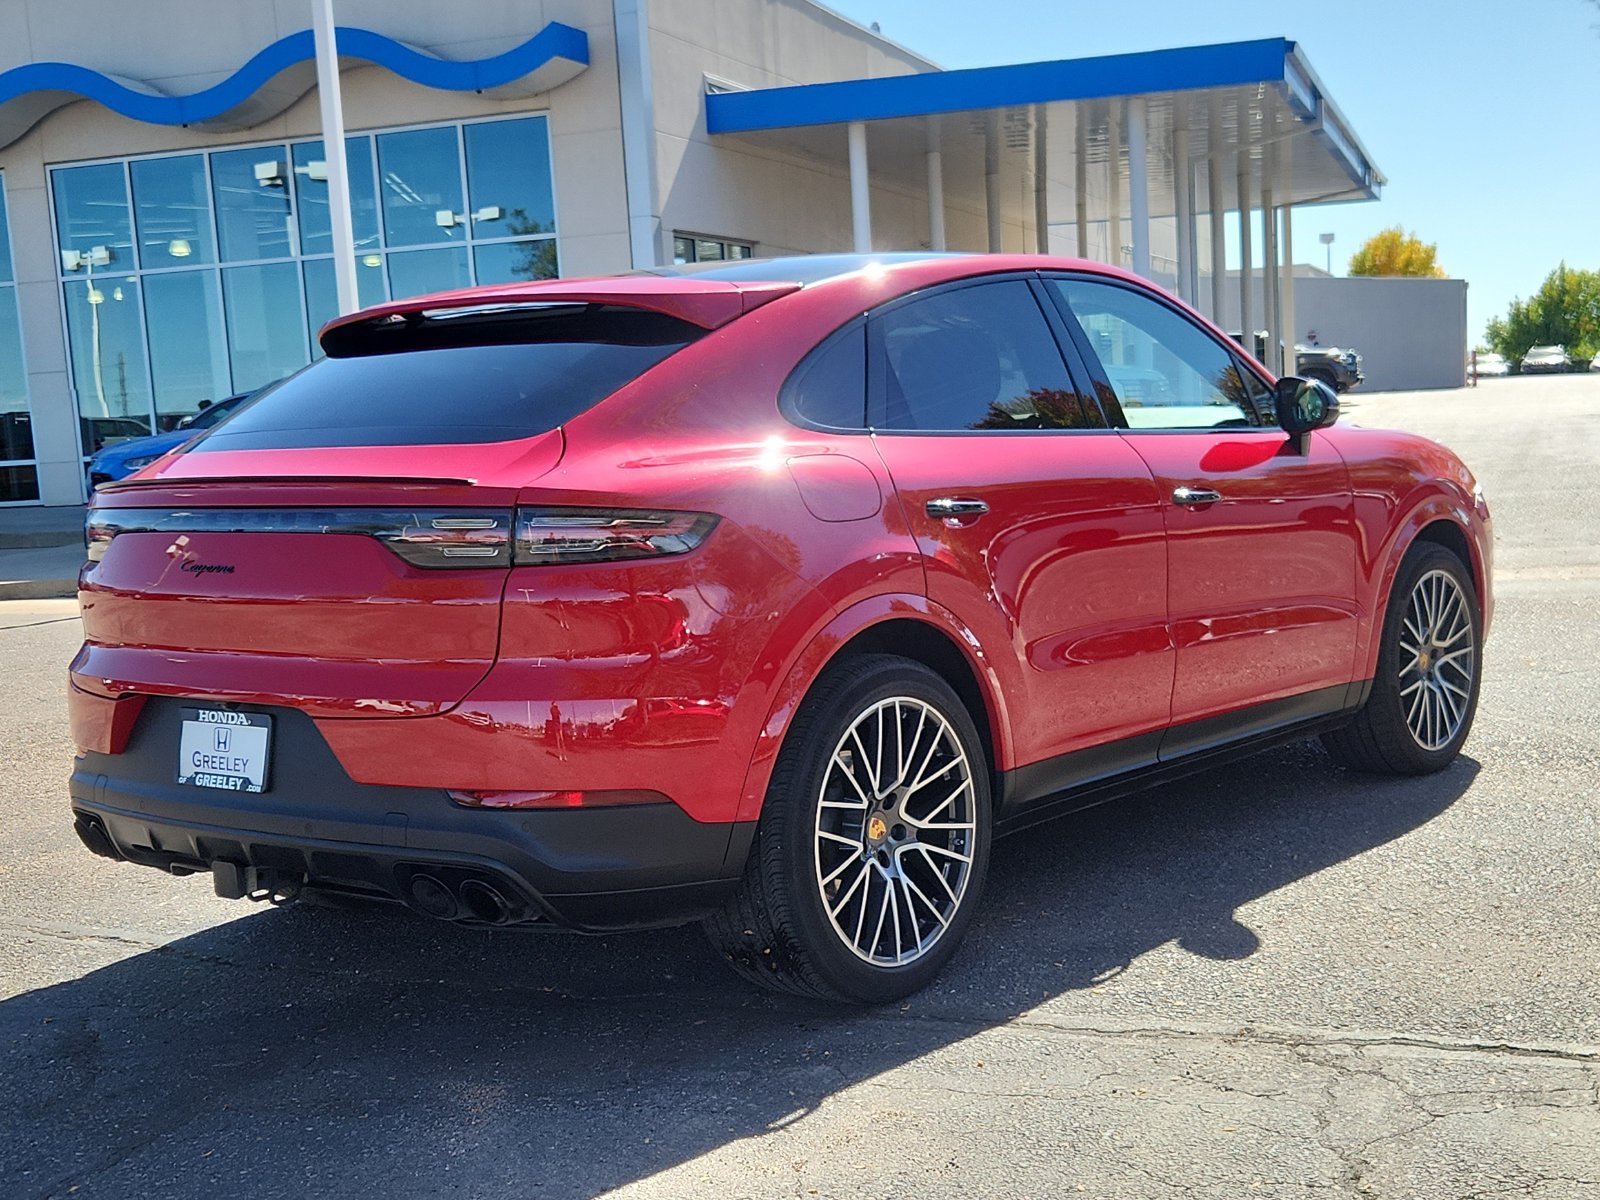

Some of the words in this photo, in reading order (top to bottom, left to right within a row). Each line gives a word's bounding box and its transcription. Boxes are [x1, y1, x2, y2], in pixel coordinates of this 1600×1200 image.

[180, 559, 236, 577] Cayenne
[198, 709, 249, 726] HONDA
[192, 751, 249, 773] GREELEY
[195, 773, 243, 791] GREELEY
